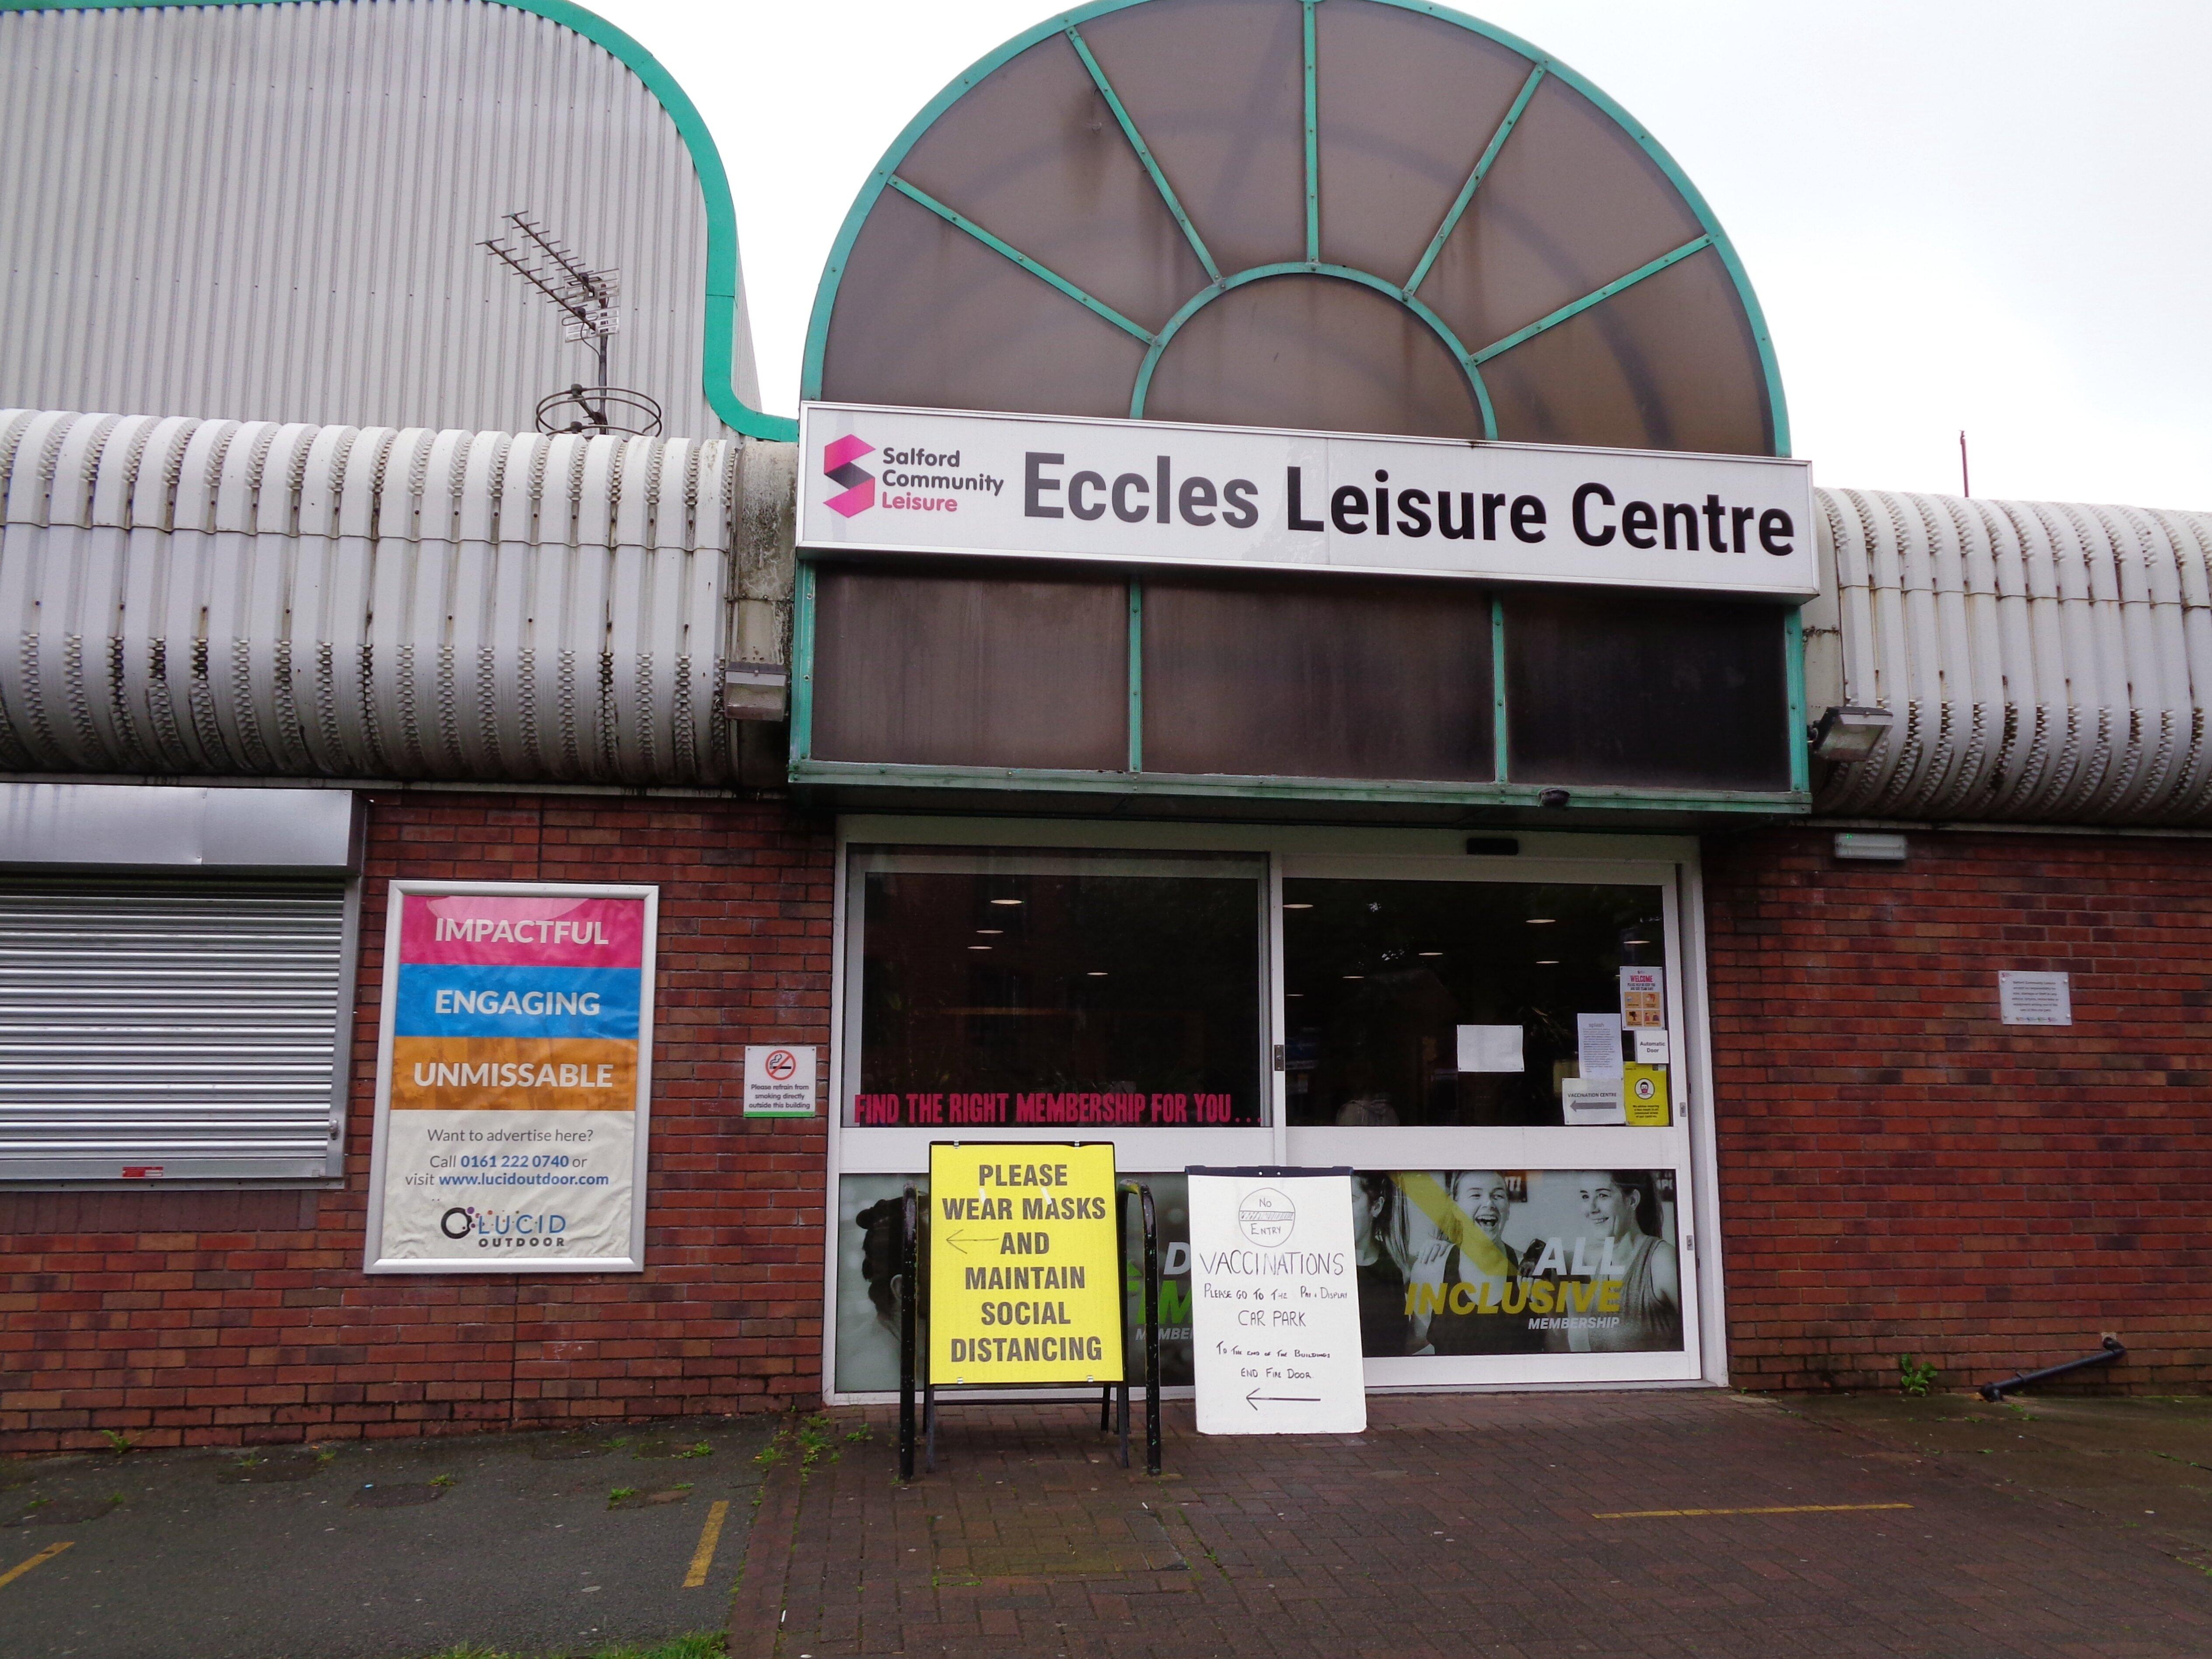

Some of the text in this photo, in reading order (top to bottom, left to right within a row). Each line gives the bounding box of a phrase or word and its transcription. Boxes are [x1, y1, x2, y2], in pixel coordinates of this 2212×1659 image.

[883, 447, 960, 467] Salford
[882, 469, 1004, 496] Community
[882, 491, 958, 512] Leisure
[1024, 451, 1794, 556] Eccles Leisure Centre
[435, 917, 609, 945] IMPACTFUL
[435, 990, 600, 1015] ENGAGING
[414, 1063, 613, 1087] UNMISSABLE
[854, 1094, 898, 1123] FIND
[906, 1094, 943, 1123] THE
[949, 1093, 1009, 1122] RIGHT
[1016, 1093, 1145, 1122] MEMBERSHIP
[1151, 1094, 1187, 1122] FOR
[427, 1129, 593, 1142] Want to advertise here?
[430, 1155, 587, 1168] Call 0161 222 0740 or
[405, 1173, 609, 1185] visit www.lucidoutdoor.com
[979, 1164, 1068, 1186] PLEASE
[942, 1197, 1106, 1220] WEAR MASKS
[478, 1214, 566, 1234] LUCID
[478, 1237, 565, 1247] OUTDOOR
[1000, 1232, 1049, 1255] AND
[1200, 1250, 1344, 1276] VACCINATIONS
[1533, 1237, 1626, 1276] ALL
[965, 1266, 1085, 1290] MAINTAIN
[1404, 1281, 1624, 1315] INCLUSIVE
[981, 1301, 1071, 1325] SOCIAL
[1238, 1310, 1306, 1327] CAR PARK
[1528, 1317, 1620, 1329] MEMBERSHIP
[951, 1336, 1102, 1363] DISTANCING
[1241, 1368, 1258, 1378] END
